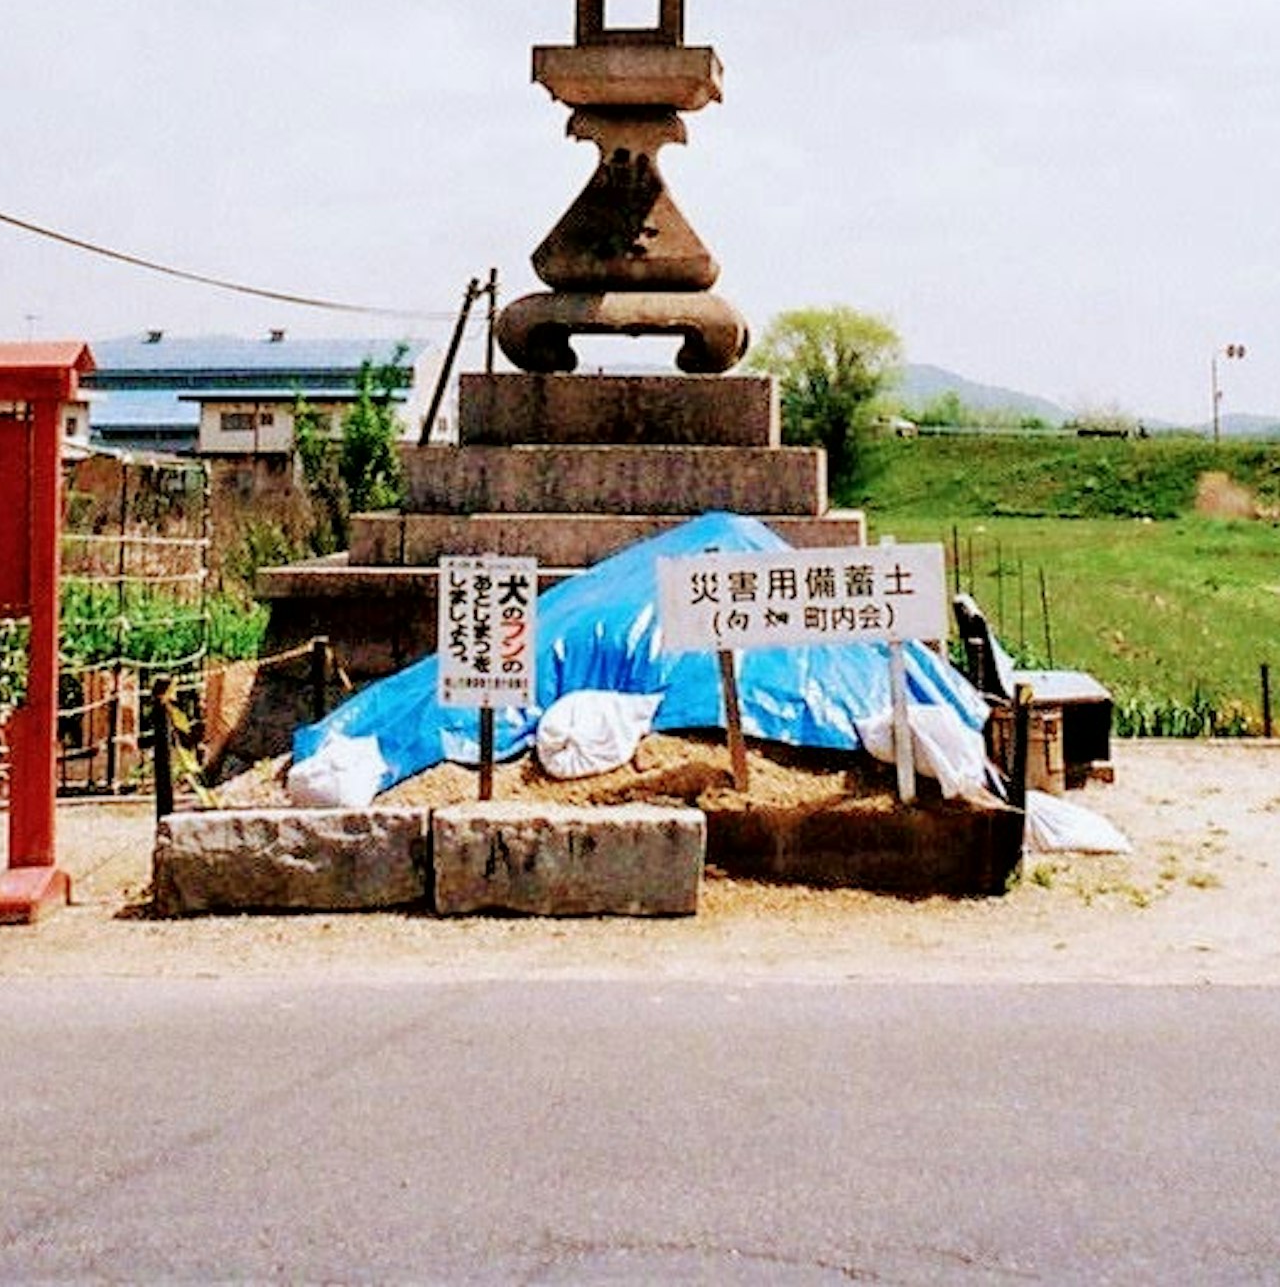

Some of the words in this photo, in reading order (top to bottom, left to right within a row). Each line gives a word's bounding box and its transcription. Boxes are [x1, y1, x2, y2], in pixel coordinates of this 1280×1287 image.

[473, 575, 493, 674] あとしまつを
[498, 575, 529, 674] 犬のフンの
[691, 564, 915, 605] 災害用備蓄土
